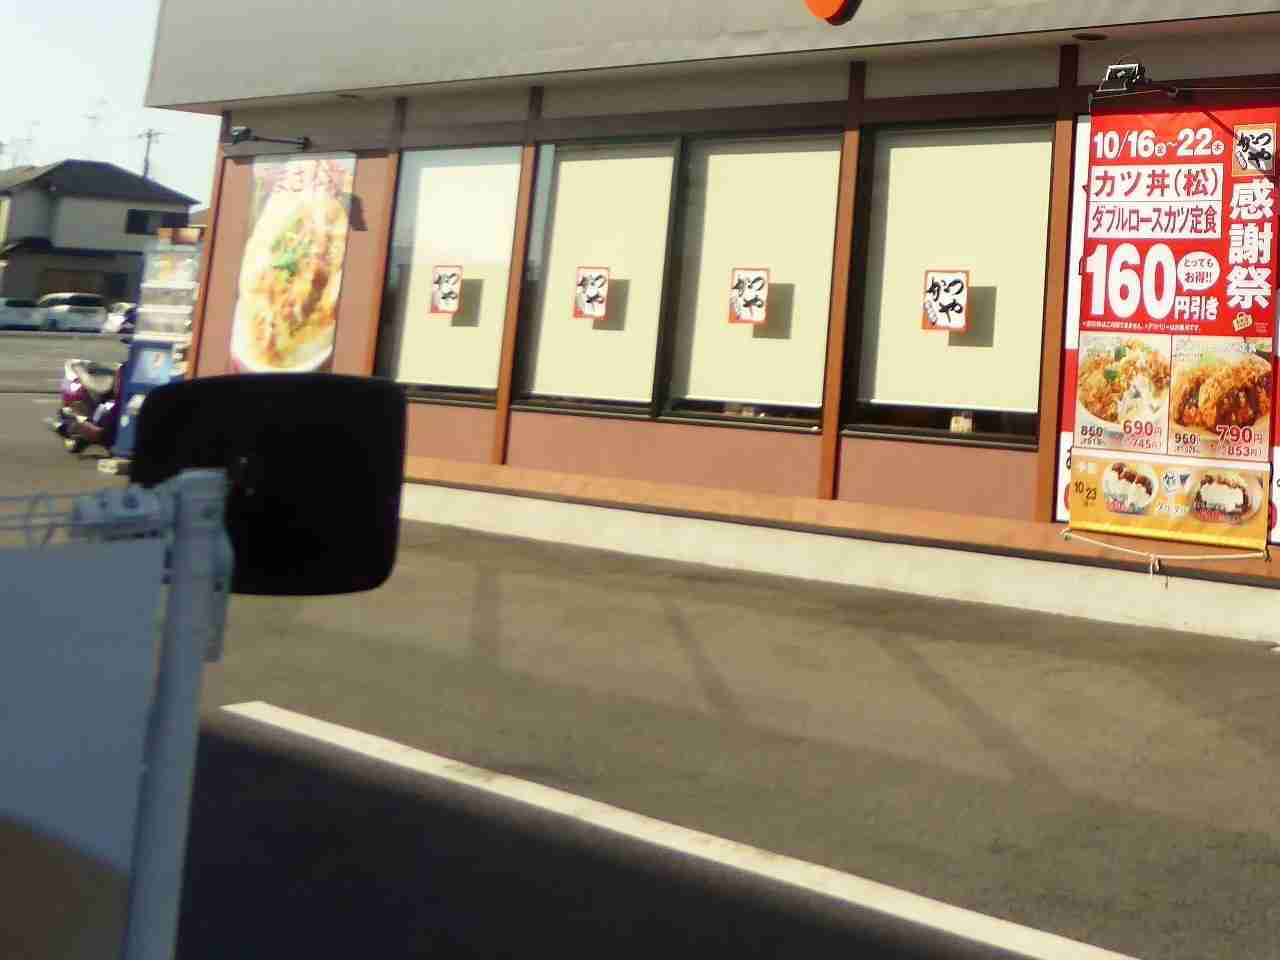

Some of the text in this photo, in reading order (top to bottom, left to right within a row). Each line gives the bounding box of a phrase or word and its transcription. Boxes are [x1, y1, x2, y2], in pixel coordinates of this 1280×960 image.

[1094, 168, 1219, 197] カツ丼(松)
[1092, 204, 1217, 234] ダブルロースカツ定食
[1226, 177, 1277, 309] 感謝祭
[1183, 257, 1214, 269] とっても
